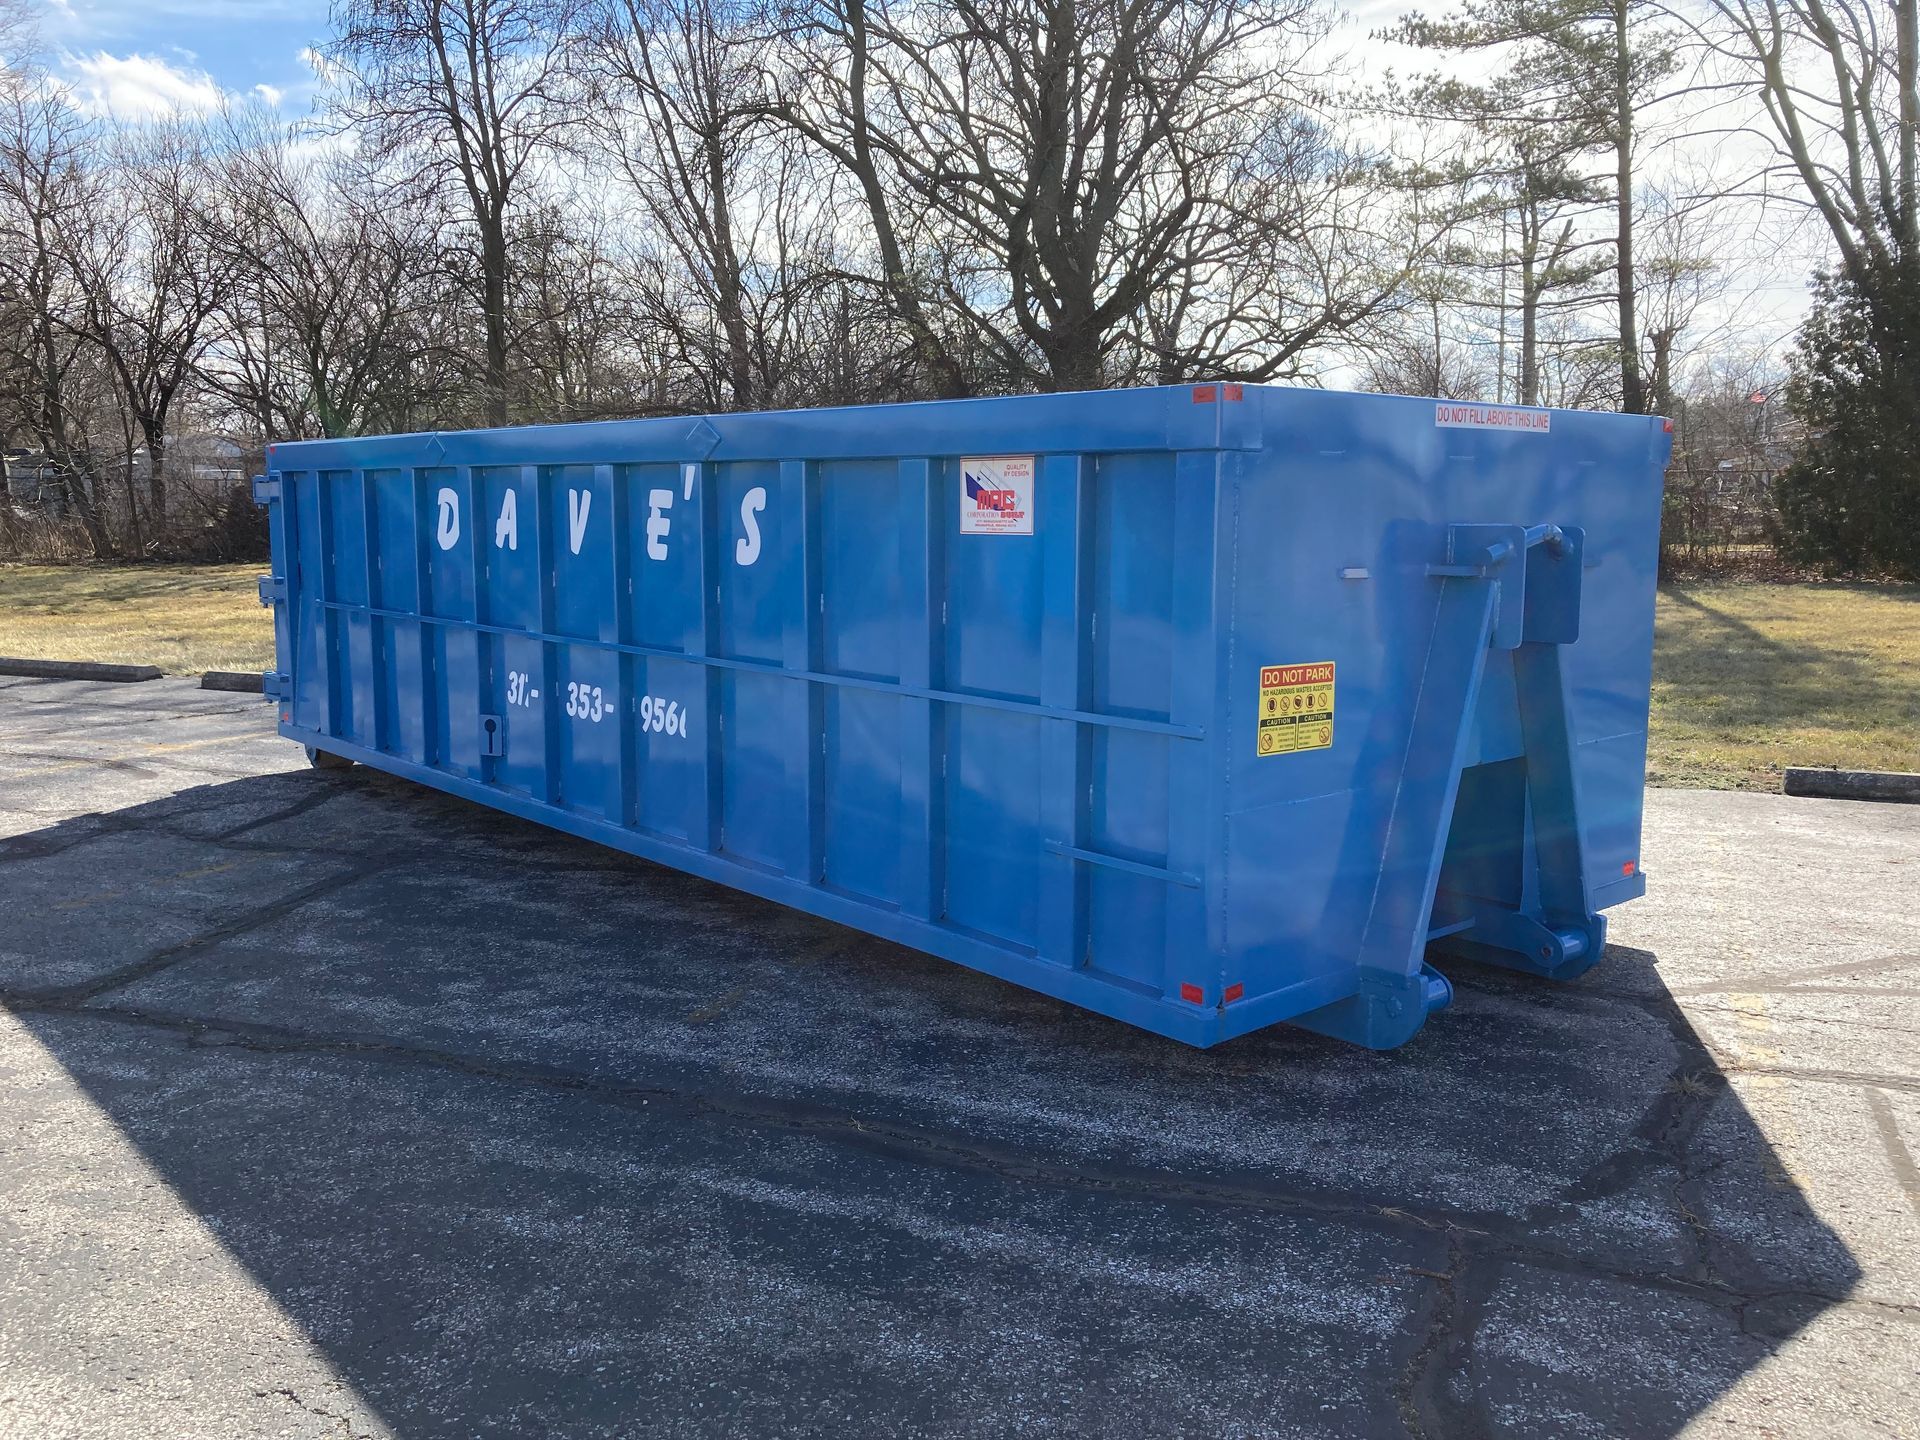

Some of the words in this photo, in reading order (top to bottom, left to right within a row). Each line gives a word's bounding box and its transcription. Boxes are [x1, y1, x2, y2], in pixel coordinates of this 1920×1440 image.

[1437, 407, 1449, 422] DO
[1451, 408, 1468, 423] NOT
[1469, 409, 1484, 424] FILL
[1486, 410, 1512, 426] ABOVE
[1514, 412, 1531, 427] THIS
[1532, 413, 1548, 429] LINE
[977, 490, 1015, 510] MAC
[437, 466, 767, 566] DAVE'S
[1264, 671, 1280, 685] DO
[1282, 669, 1303, 683] NOT
[1305, 666, 1332, 681] PARK
[1269, 687, 1295, 696] HAZARDOUS
[1295, 685, 1312, 694] WASTES
[1312, 683, 1332, 692] ACCEPTED
[1266, 717, 1291, 726] CAUTION
[1304, 714, 1327, 722] CAUTION
